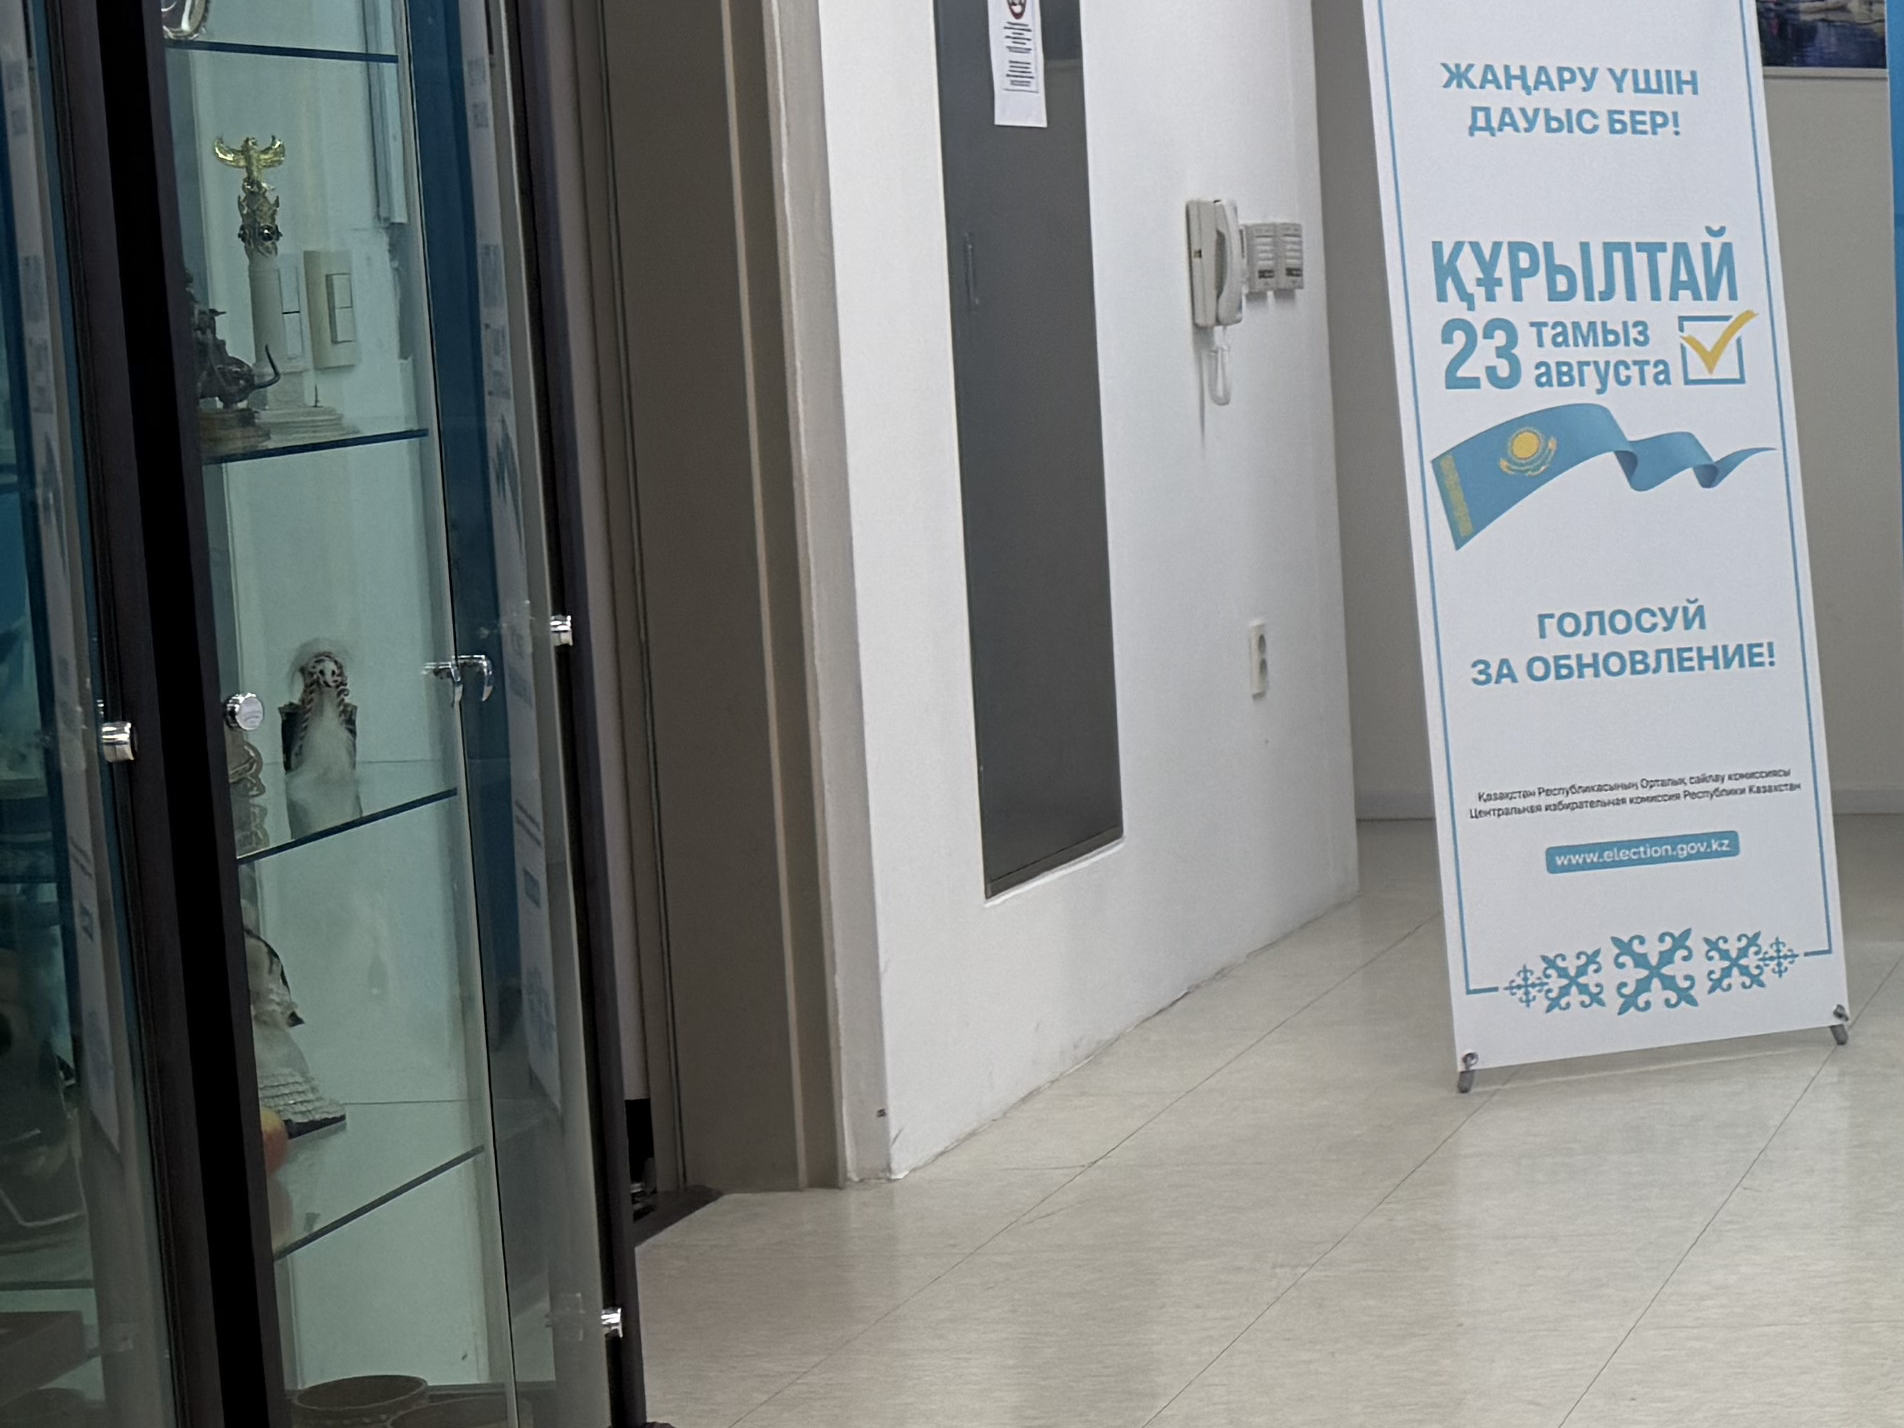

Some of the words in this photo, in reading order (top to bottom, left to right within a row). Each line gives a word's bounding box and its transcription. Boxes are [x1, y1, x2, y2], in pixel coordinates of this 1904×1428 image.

[1440, 62, 1599, 96] ЖАҢАРУ
[1608, 66, 1699, 95] ҮШІН
[1467, 106, 1600, 137] ДАУЫС
[1607, 108, 1682, 136] БЕР!
[1431, 225, 1739, 311] ҚҰРЫЛТАЙ
[1440, 317, 1523, 390] 23
[1530, 319, 1650, 348] тамыз
[1533, 356, 1672, 394] августа
[1537, 598, 1707, 640] ГОЛОСУЙ
[1470, 658, 1519, 686] ЗА
[1525, 641, 1776, 682] ОБНОВЛЕНИЕ!
[1469, 803, 1542, 820] Центральная
[1629, 792, 1681, 805] комиссия
[1683, 786, 1746, 801] Республики
[1554, 836, 1730, 869] www.election.gov.kz
